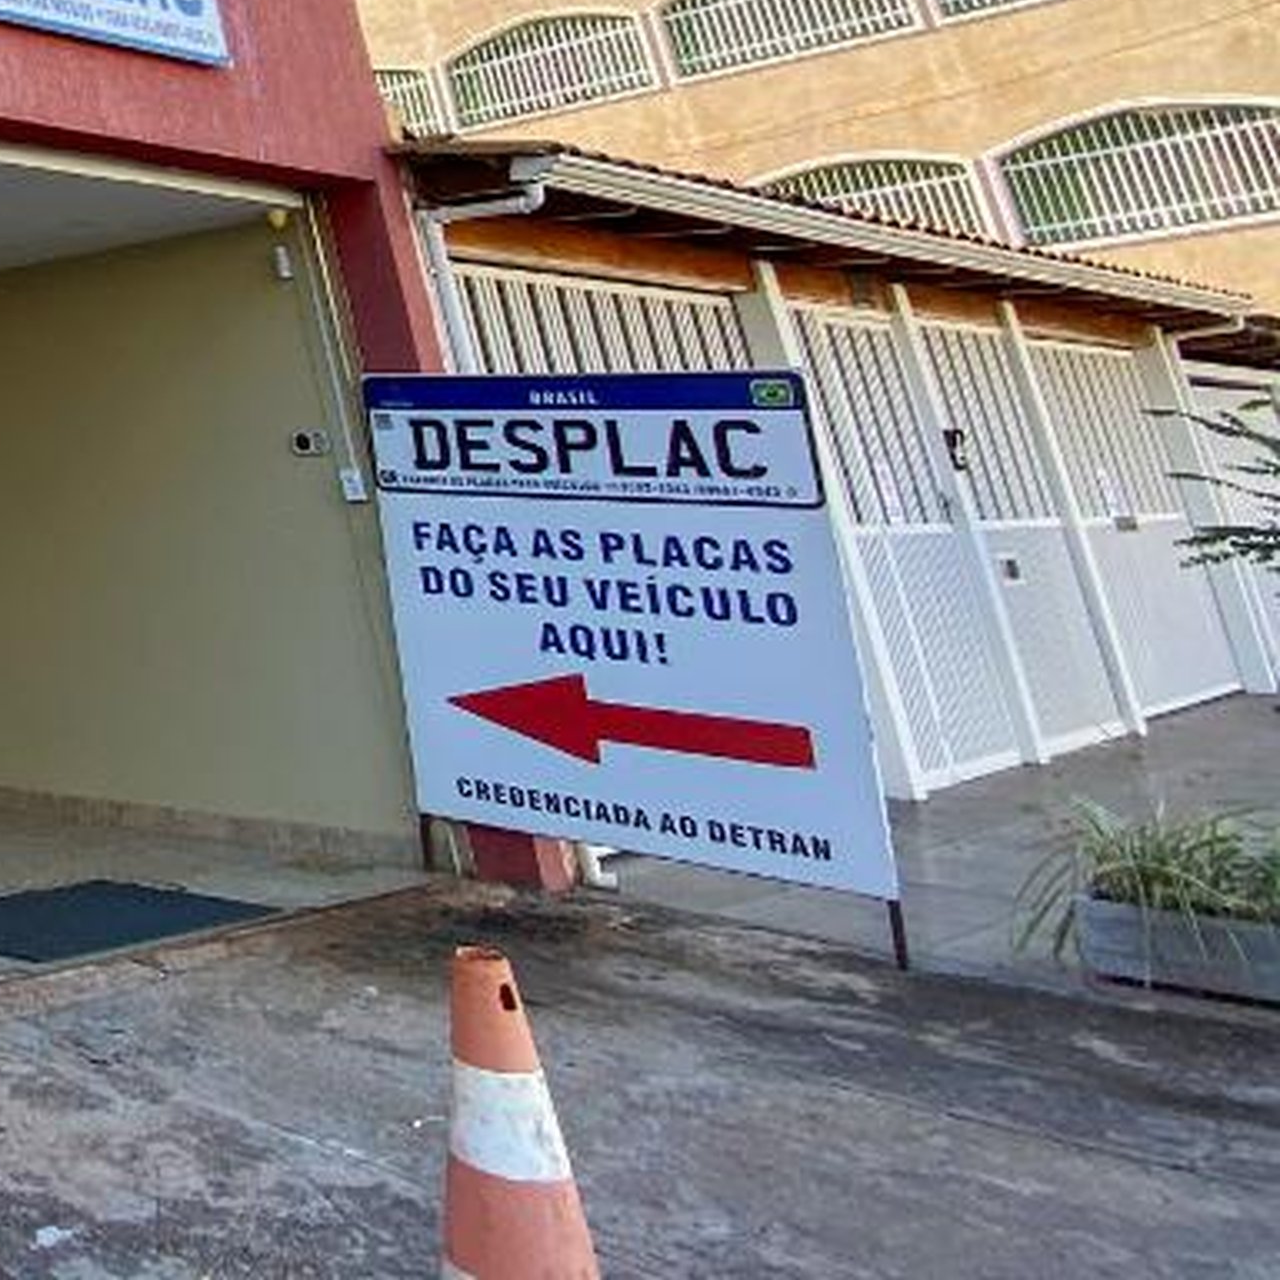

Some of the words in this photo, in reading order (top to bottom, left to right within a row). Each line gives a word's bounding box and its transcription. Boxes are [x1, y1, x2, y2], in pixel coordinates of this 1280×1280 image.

[529, 389, 599, 406] BRASIL
[408, 418, 768, 480] DESPLAC
[412, 521, 518, 564] FAÇA
[530, 528, 585, 562] AS
[598, 531, 794, 575] PLACAS
[419, 565, 475, 599] DO
[488, 570, 570, 608] SEU
[582, 574, 799, 628] VEÍCULO
[538, 621, 669, 665] AQUI!
[455, 775, 652, 832] CREDENCIADA
[658, 812, 699, 839] AO
[707, 818, 833, 861] DETRAN
